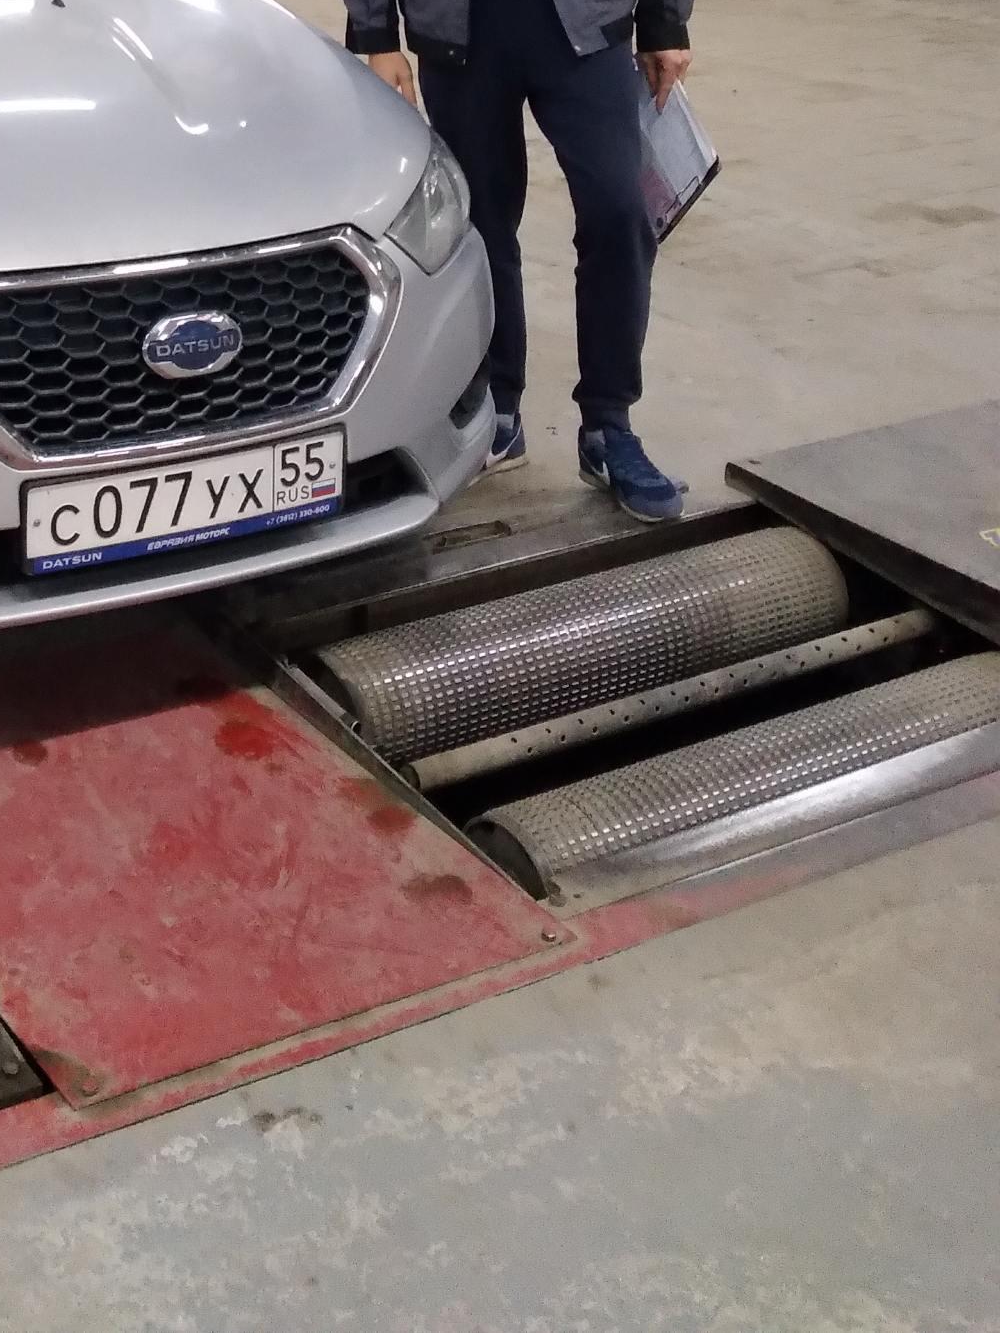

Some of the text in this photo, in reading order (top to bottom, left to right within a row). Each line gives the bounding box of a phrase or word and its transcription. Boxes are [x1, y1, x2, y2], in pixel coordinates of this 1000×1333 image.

[155, 335, 235, 358] DATSUN
[279, 441, 325, 488] 55
[277, 485, 310, 504] RUS
[42, 552, 102, 571] DATSUN
